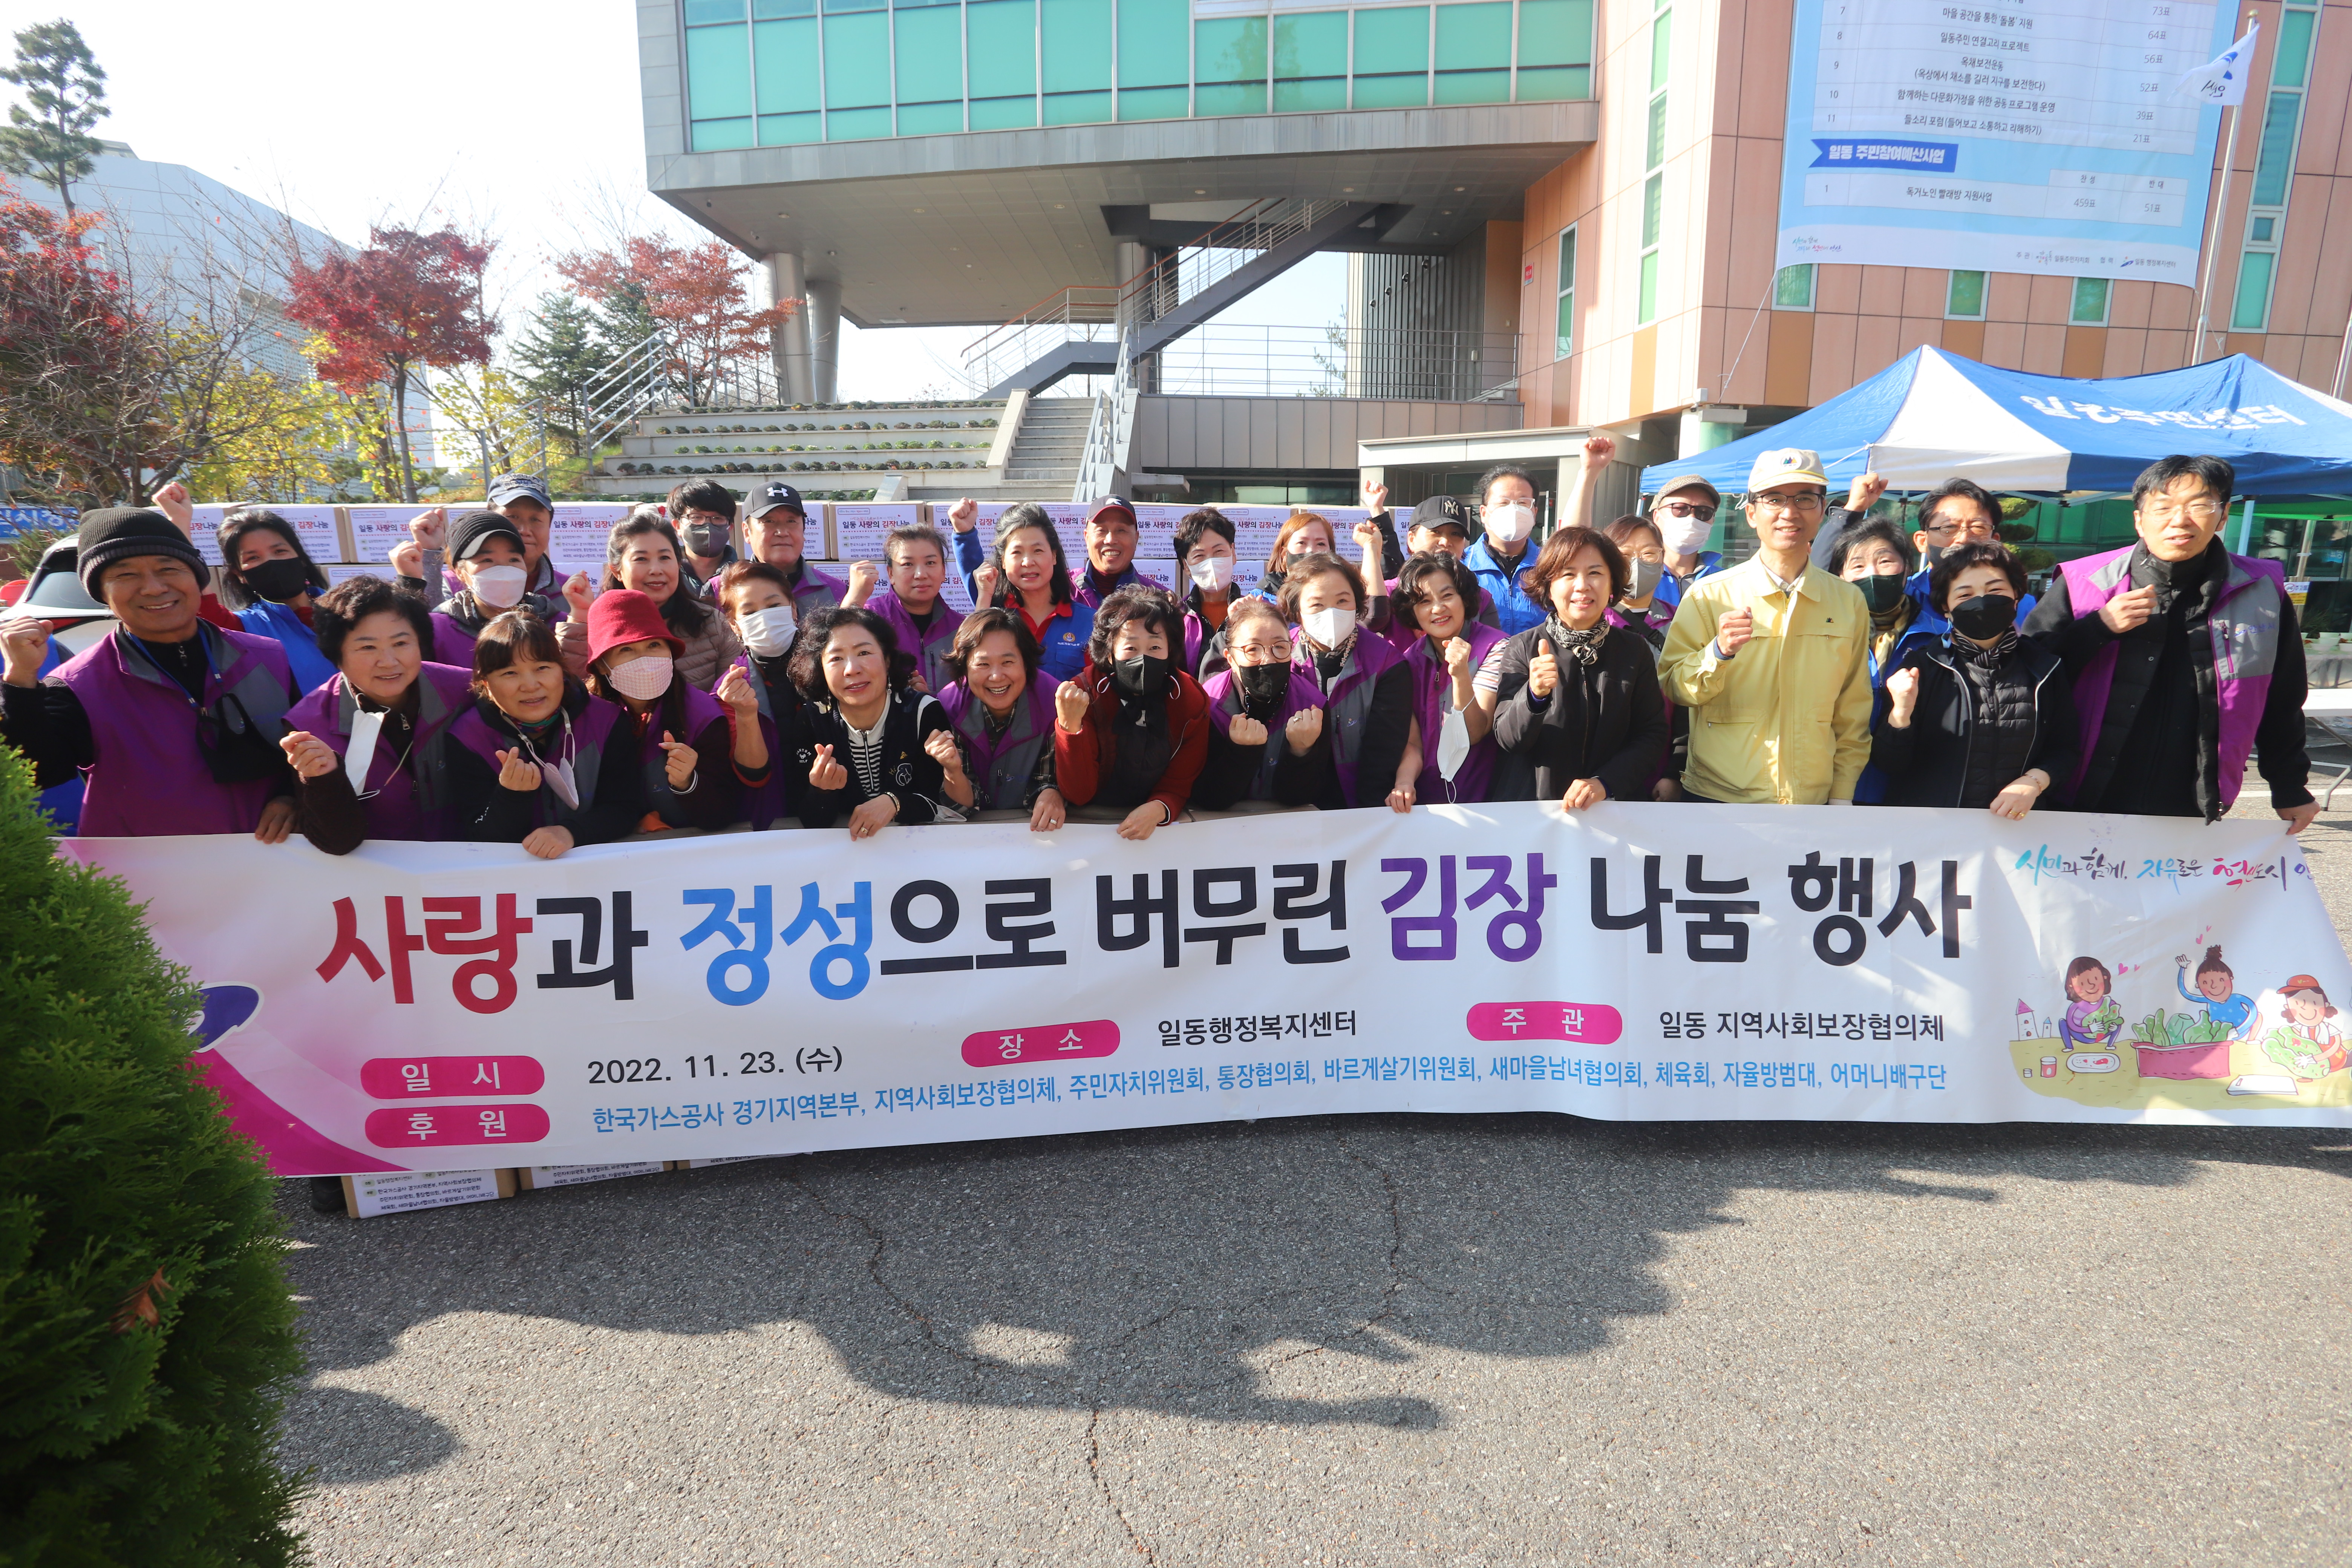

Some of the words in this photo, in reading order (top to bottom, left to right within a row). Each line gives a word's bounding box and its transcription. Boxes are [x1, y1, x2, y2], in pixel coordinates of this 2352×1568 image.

[1840, 6, 1845, 15] 7
[2152, 6, 2170, 15] 73표
[1943, 8, 1957, 19] 마을
[1960, 9, 1981, 22] 공간을
[1983, 12, 1997, 24] 통한
[2019, 18, 2033, 29] 지원
[1940, 32, 1970, 45] 일동주민
[1972, 36, 1999, 49] 연결고리
[2001, 40, 2029, 52] 프로젝트
[2148, 31, 2166, 40] 64표
[1961, 57, 2003, 71] 옥채보전운동
[2144, 55, 2162, 64] 56표
[1914, 68, 1948, 82] (옥상에서
[1950, 71, 1971, 84] 채소를
[1974, 74, 1989, 85] 길러
[1991, 76, 2010, 89] 지구를
[2012, 78, 2045, 92] 보전한다)
[2140, 83, 2158, 92] 52표
[1897, 89, 1929, 101] 함께하는
[1931, 92, 1975, 106] 다문화가정을
[1977, 96, 1992, 107] 위한
[1993, 98, 2006, 109] 공동
[2008, 100, 2038, 112] 프로그램
[2039, 103, 2055, 113] 운영
[1904, 114, 1927, 126] 들소리
[1979, 121, 2007, 132] 소통하고
[2136, 111, 2153, 120] 39표
[2133, 135, 2150, 143] 21표
[1828, 145, 1853, 160] 일동
[1856, 145, 1945, 164] 주민참여예산사업
[1906, 187, 1936, 198] 독거노인
[1939, 189, 1961, 200] 빨래방
[1965, 191, 1992, 202] 지원사업
[2073, 199, 2096, 208] 459표
[2144, 204, 2161, 213] 51표
[1444, 500, 1459, 516] NY
[298, 521, 328, 529] 김장나눔
[2137, 856, 2203, 894] 자유로운
[316, 891, 648, 1015] 사랑과
[679, 878, 1066, 1006] 정성으로
[1096, 859, 1351, 969] 버무린
[1381, 853, 1557, 962] 김장
[1590, 854, 1760, 963] 나눔
[1787, 850, 1972, 966] 행사
[1158, 1011, 1357, 1046] 일동행정복지센터
[1659, 1012, 1707, 1039] 일동
[1717, 1012, 1944, 1041] 지역사회보장협의체
[588, 1059, 672, 1085] 2022.
[684, 1055, 729, 1079] 11.
[740, 1051, 784, 1076] 23.
[795, 1046, 843, 1075] (수)
[592, 1104, 723, 1134] 한국가스공사
[732, 1092, 866, 1126] 경기지역본부,
[875, 1077, 1062, 1114] 지역사회보장협의체,
[1070, 1066, 1210, 1101] 주민자치위원회,
[1217, 1058, 1316, 1092] 통장협의회,
[1324, 1055, 1482, 1084] 바르게살기위원회,
[1490, 1055, 1648, 1090] 새마을남녀협의회,
[1655, 1061, 1716, 1089] 체육회,
[1723, 1062, 1822, 1090] 자율방범대,
[1830, 1063, 1947, 1091] 어머니배구단
[378, 1186, 406, 1194] 한국가스공사
